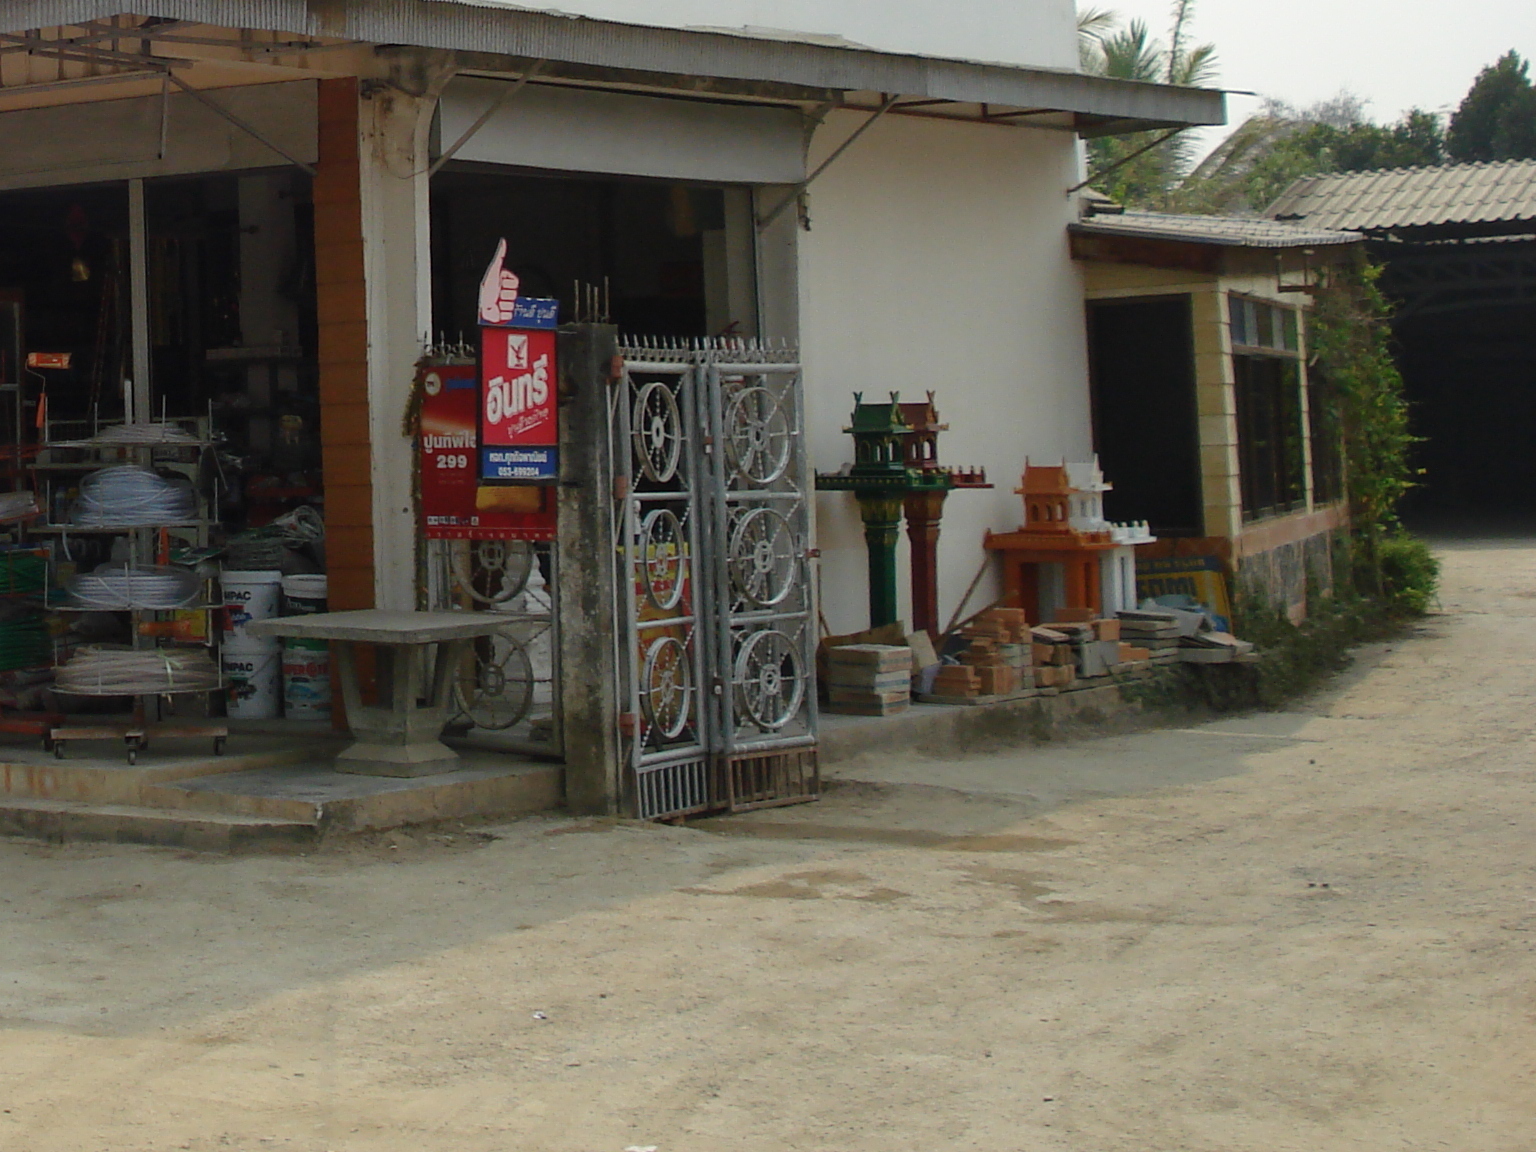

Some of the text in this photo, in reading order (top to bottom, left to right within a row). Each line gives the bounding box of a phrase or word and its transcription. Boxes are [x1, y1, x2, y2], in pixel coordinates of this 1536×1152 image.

[486, 353, 549, 425] อินทรี
[436, 454, 468, 469] 299
